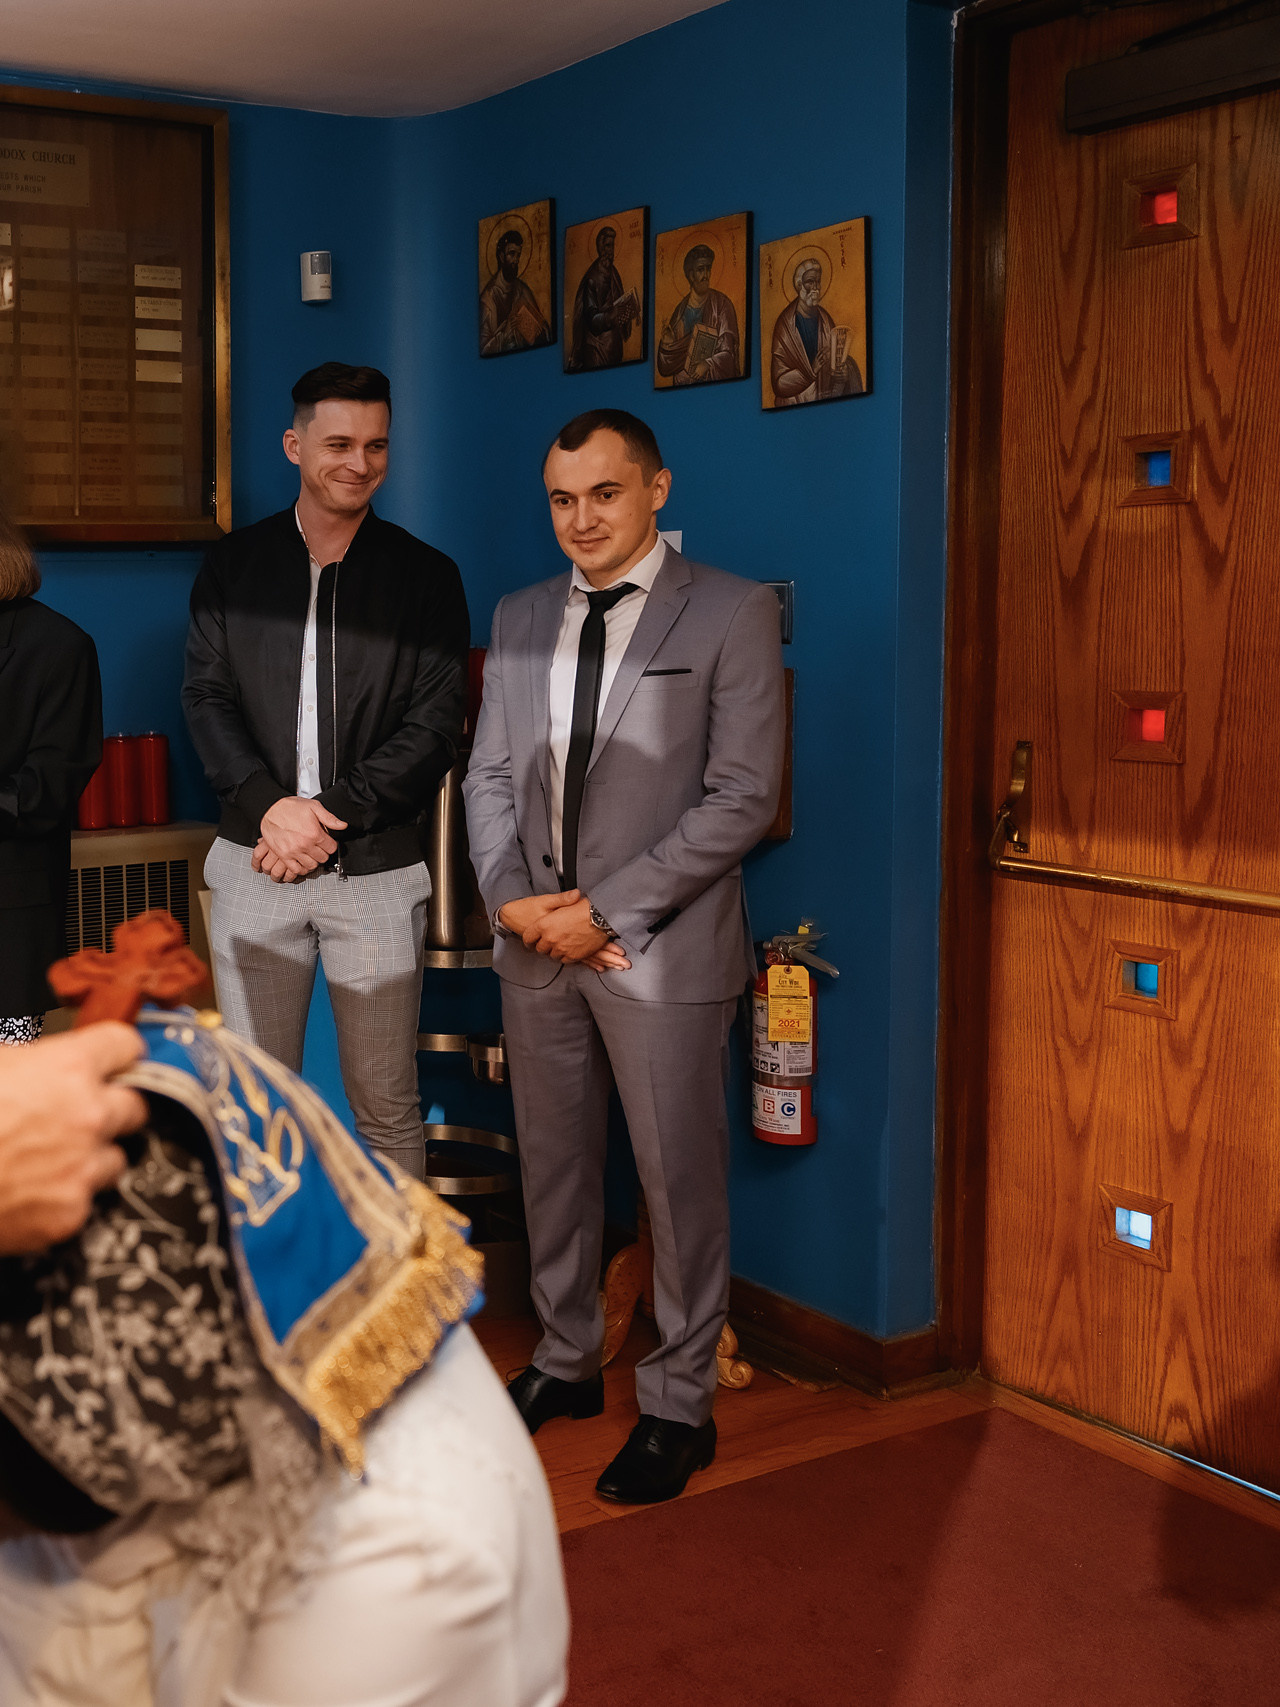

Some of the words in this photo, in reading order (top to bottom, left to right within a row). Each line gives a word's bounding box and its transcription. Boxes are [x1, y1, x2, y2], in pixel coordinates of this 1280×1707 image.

[32, 151, 76, 165] CHURCH
[16, 184, 42, 194] PARISH
[778, 1019, 800, 1028] 2021
[764, 1088, 776, 1096] ALL
[764, 1100, 774, 1112] B
